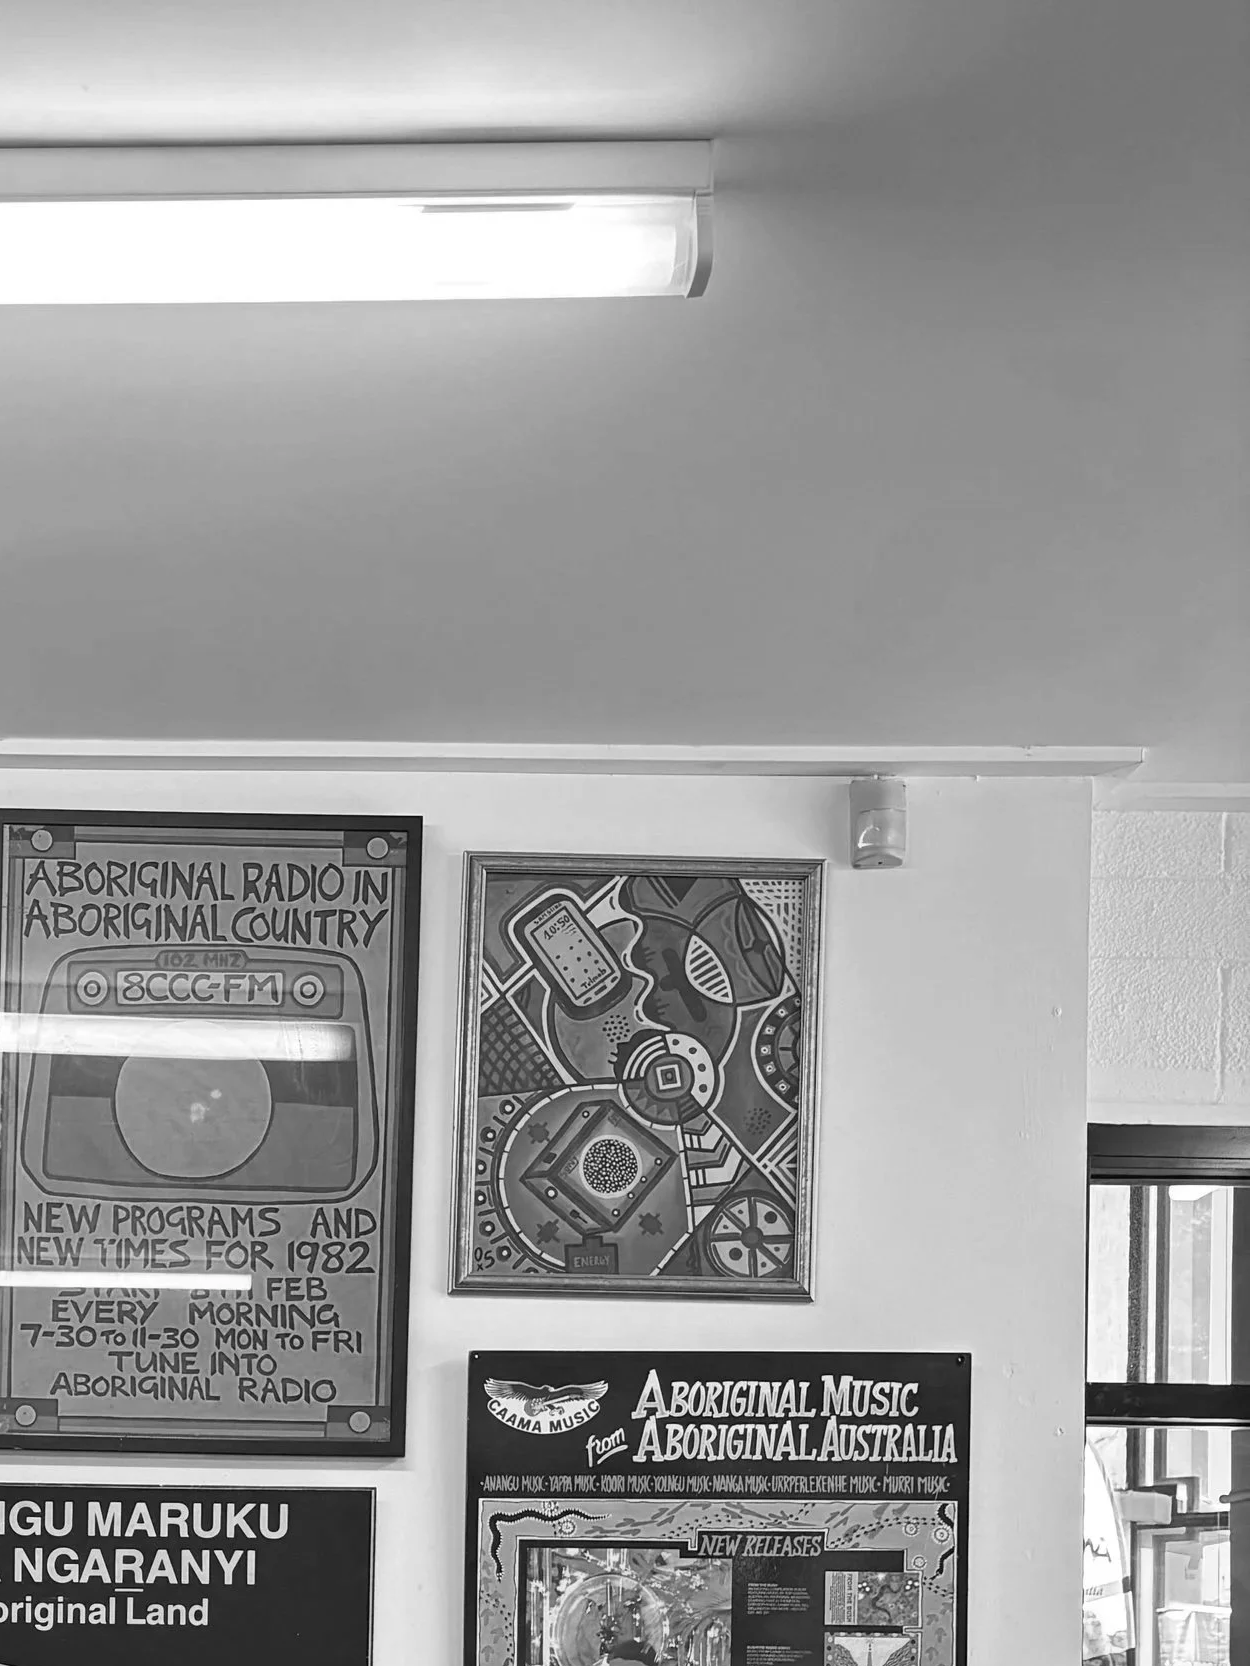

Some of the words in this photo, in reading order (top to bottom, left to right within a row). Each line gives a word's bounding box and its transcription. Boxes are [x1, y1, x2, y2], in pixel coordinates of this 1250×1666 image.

[25, 860, 235, 901] ABORIGINAL
[243, 862, 344, 905] RADIO
[353, 868, 389, 906] IN
[23, 899, 228, 943] ABORIGINAL
[231, 906, 390, 949] COUNTRY
[162, 953, 198, 969] 102
[122, 972, 280, 1003] 8CCC-FM
[23, 1201, 102, 1235] NEW
[113, 1205, 282, 1239] PROGRAMS
[311, 1208, 378, 1239] AND
[17, 1237, 84, 1267] NEW
[94, 1238, 192, 1270] TIMES
[205, 1240, 275, 1271] FOR
[287, 1241, 376, 1273] 1982
[267, 1277, 328, 1302] FEB
[51, 1300, 159, 1326] EVERY
[189, 1303, 340, 1330] MORNING
[20, 1323, 97, 1349] 7-30
[132, 1326, 199, 1350] 11-30
[215, 1327, 268, 1352] MON
[312, 1330, 362, 1354] FRI
[107, 1351, 200, 1375] TUNE
[211, 1353, 278, 1376] INTO
[49, 1372, 221, 1401] ABORIGINAL
[238, 1377, 337, 1404] RADIO
[631, 1369, 816, 1420] ABORIGINAL
[820, 1374, 919, 1417] MUSIC
[488, 1400, 542, 1433] CAAMA
[550, 1400, 600, 1433] MUSIC
[586, 1427, 626, 1468] from
[632, 1415, 816, 1463] ABORIGINAL
[817, 1415, 958, 1463] AUSTRALIA
[87, 1501, 289, 1539] MARUKU
[700, 1535, 742, 1557] NEW
[742, 1535, 822, 1557] RELEASES
[126, 1597, 209, 1626] Land
